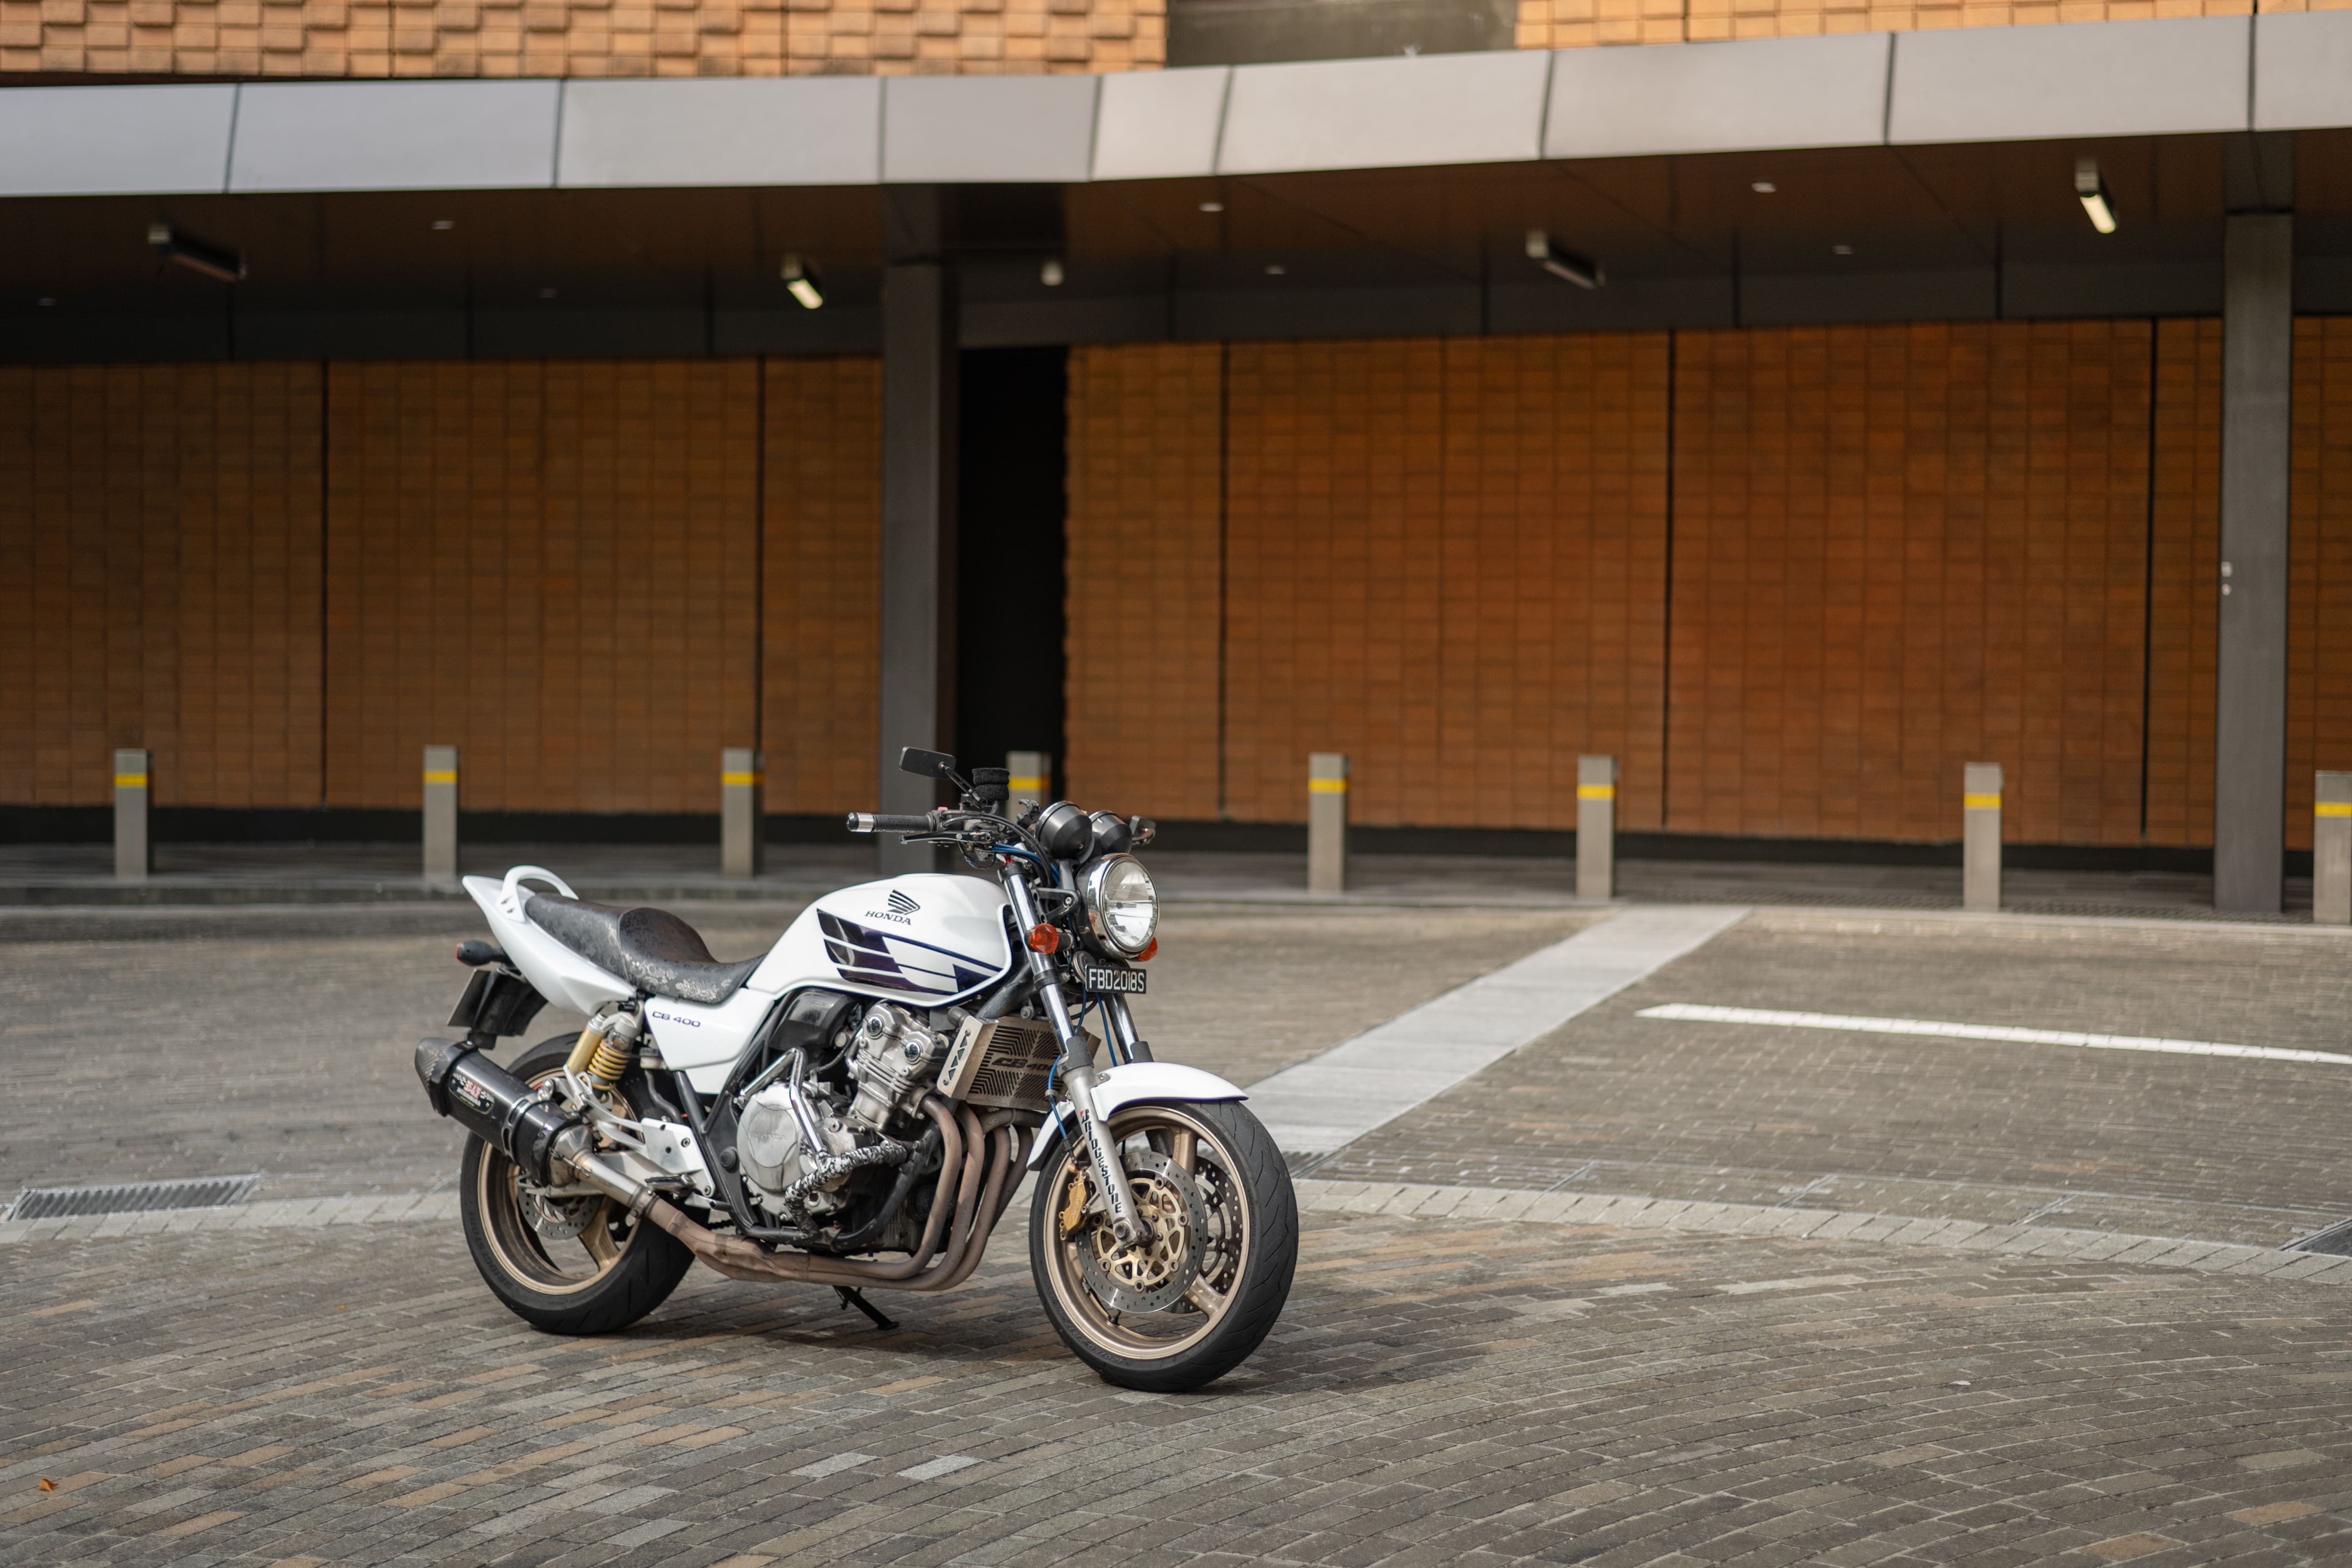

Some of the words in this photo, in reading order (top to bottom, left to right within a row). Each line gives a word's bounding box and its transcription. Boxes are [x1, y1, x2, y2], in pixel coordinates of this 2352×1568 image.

[865, 911, 911, 925] HONDA
[1089, 969, 1144, 992] FBD2018S
[652, 1011, 671, 1020] CB
[673, 1017, 700, 1027] 400
[991, 1058, 1028, 1068] CB
[1080, 1109, 1122, 1213] BRIDGESTONE
